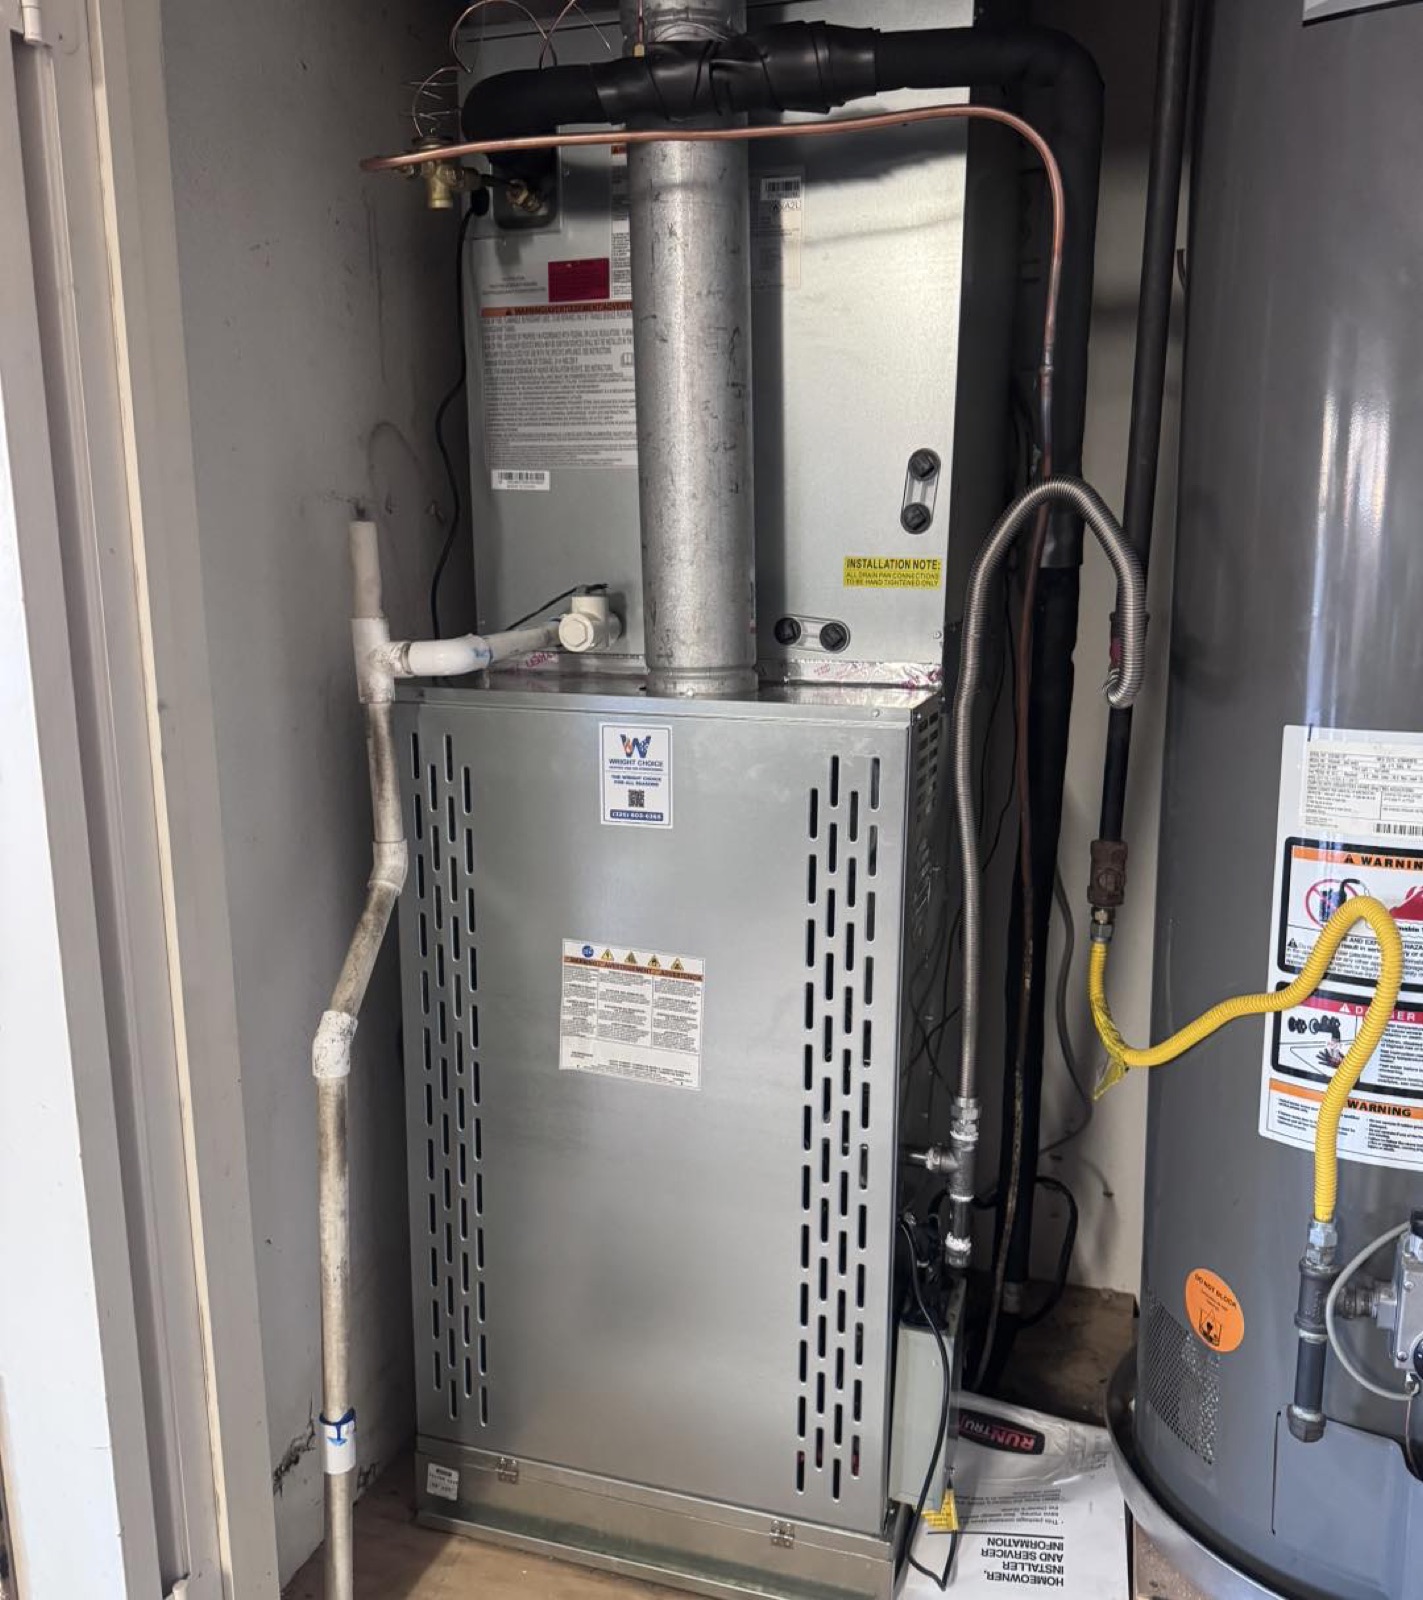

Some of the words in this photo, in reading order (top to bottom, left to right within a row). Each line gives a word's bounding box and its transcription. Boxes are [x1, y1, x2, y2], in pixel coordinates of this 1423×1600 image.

[846, 558, 911, 570] INSTALLATION
[912, 559, 941, 570] NOTE:
[1361, 856, 1423, 870] WARNIN
[1355, 1005, 1416, 1022] DER
[1347, 1099, 1412, 1117] WARNING
[986, 1537, 1064, 1551] INFORMATION
[981, 1548, 1037, 1561] SERVICER
[1039, 1552, 1064, 1563] AND
[1002, 1561, 1064, 1575] INSTALLER
[983, 1570, 1064, 1588] HOMEOWNER,
